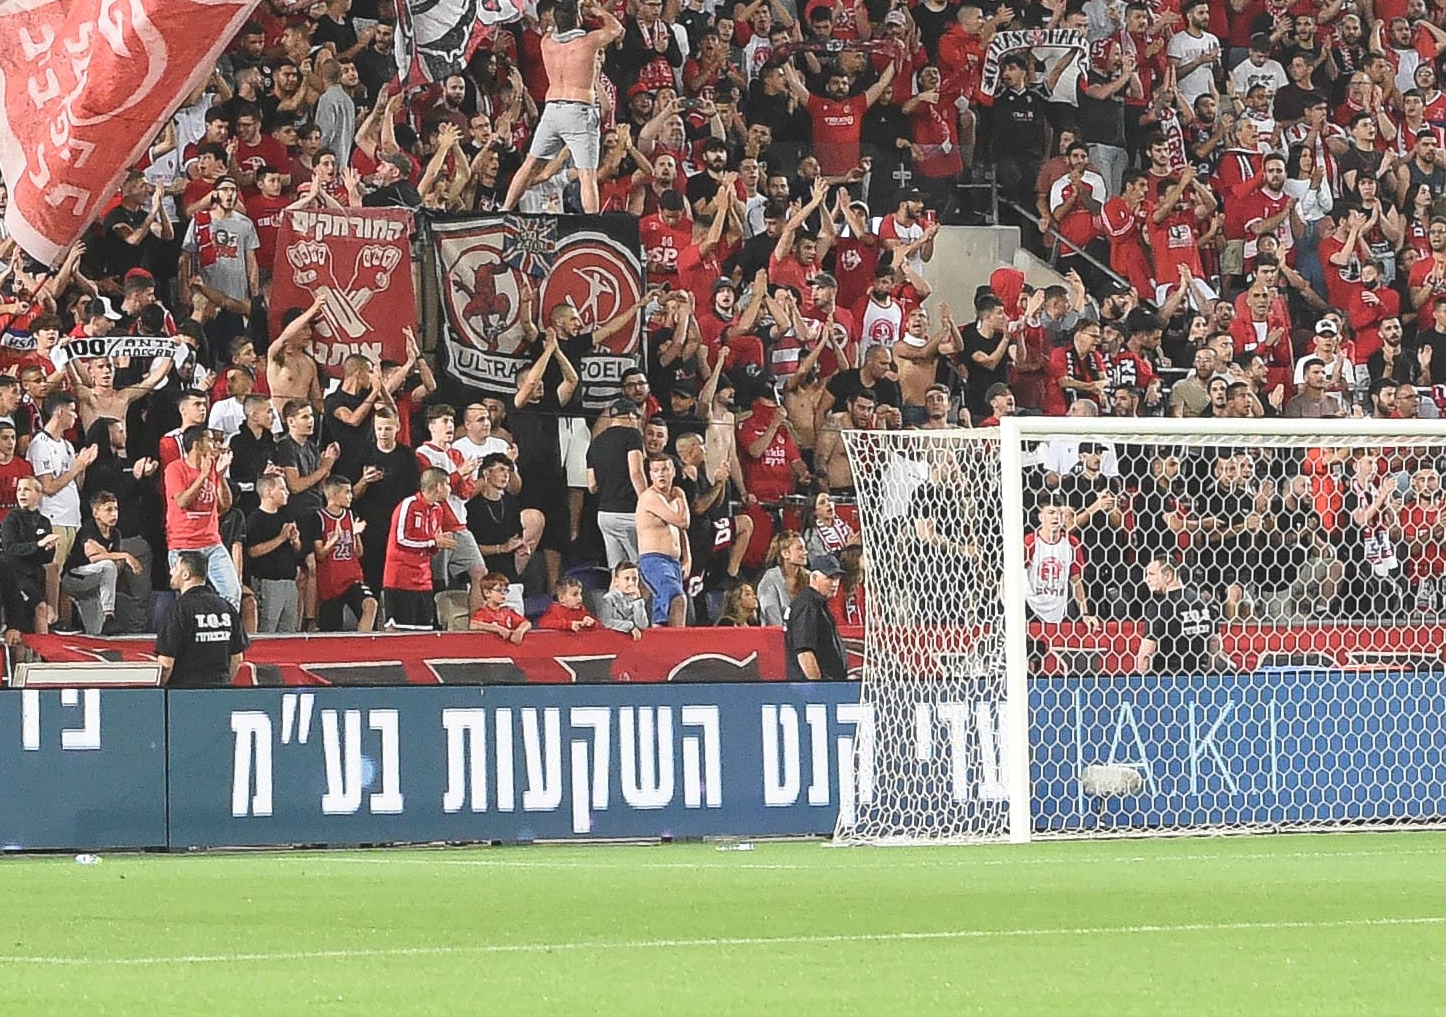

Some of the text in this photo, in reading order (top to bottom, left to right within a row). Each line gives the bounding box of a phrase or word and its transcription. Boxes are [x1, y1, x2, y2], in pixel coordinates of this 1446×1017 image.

[66, 338, 122, 360] 100%
[457, 349, 626, 382] ULTRA POEL
[334, 543, 353, 561] 23
[195, 612, 232, 628] T.Q.S
[230, 693, 405, 817] בע"מ
[442, 703, 723, 834] השקעות
[761, 702, 876, 829] קנט
